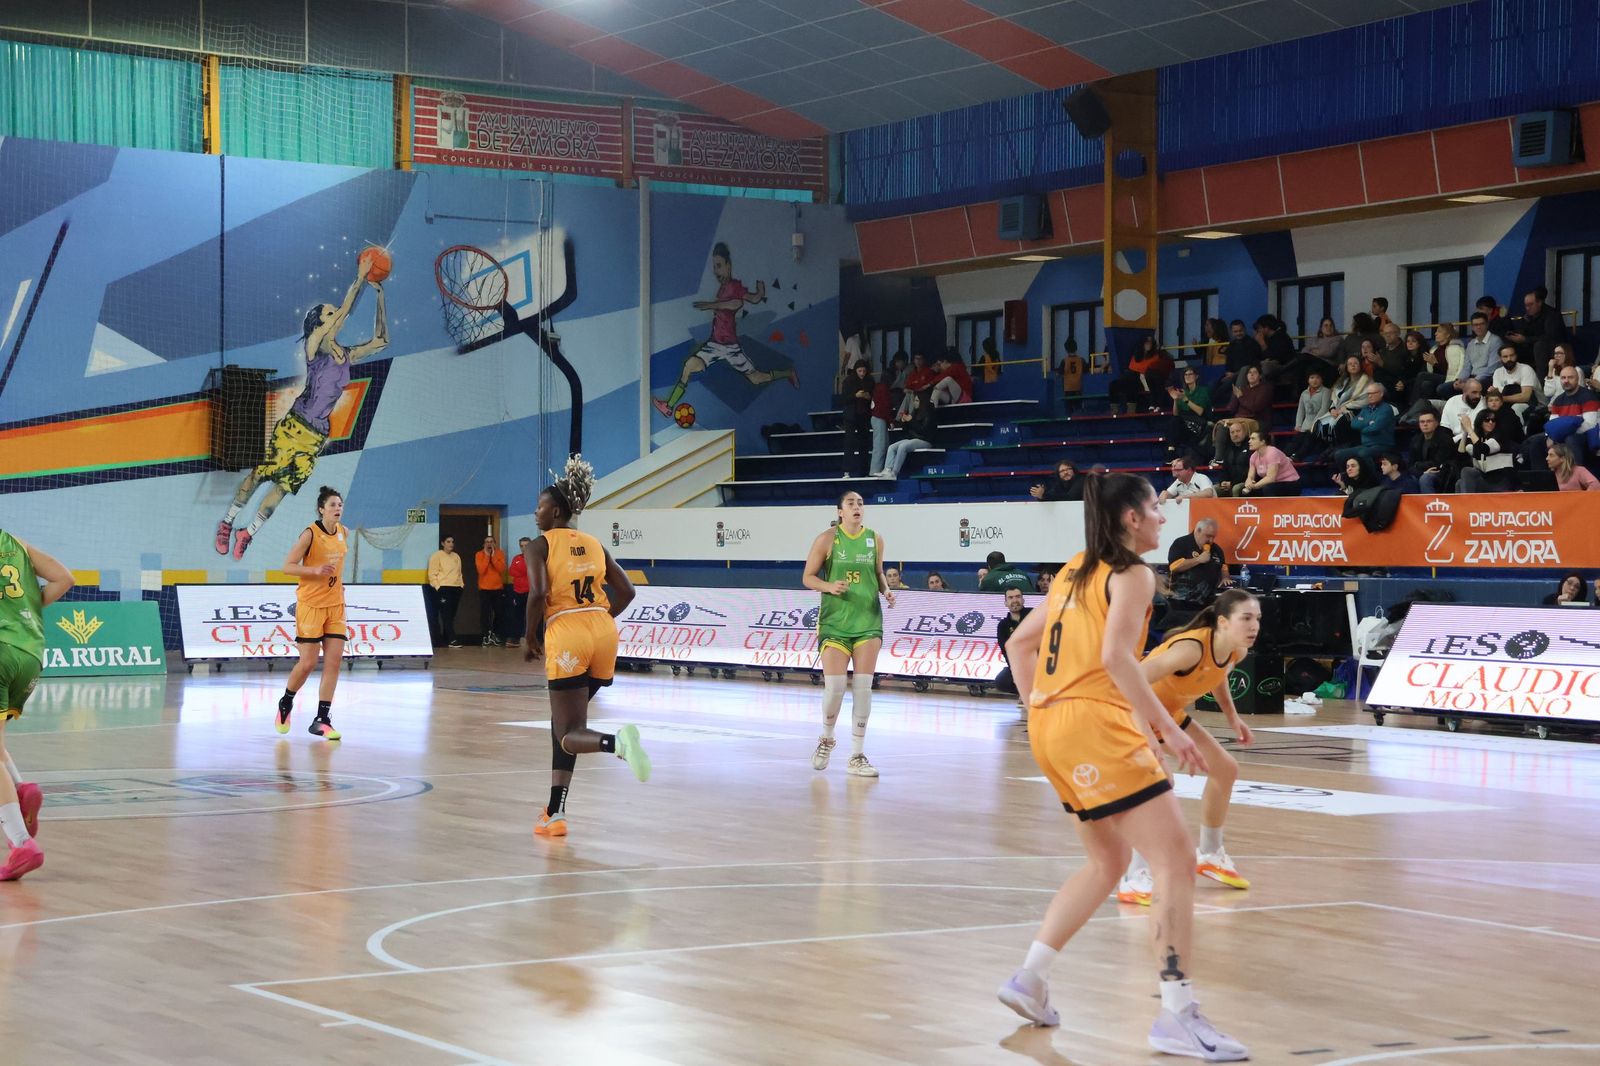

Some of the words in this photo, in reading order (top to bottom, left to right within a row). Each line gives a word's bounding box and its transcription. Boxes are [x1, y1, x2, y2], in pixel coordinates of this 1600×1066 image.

[478, 112, 600, 138] AYUNTAMIENTO
[477, 129, 502, 150] DE
[508, 132, 600, 159] ZAMORA
[542, 164, 595, 174] DEPORTES
[690, 148, 714, 166] DE
[720, 150, 801, 171] ZAMORA
[620, 529, 643, 540] ZAMORA
[725, 529, 751, 540] ZAMORA
[971, 527, 1003, 539] ZAMORA
[1268, 540, 1348, 562] ZAMORA
[1464, 540, 1560, 564] ZAMORA
[846, 570, 861, 584] 55
[571, 576, 595, 604] 14
[211, 602, 283, 620] IES
[628, 604, 668, 621] IES
[755, 608, 802, 626] IES
[901, 613, 955, 632] IES
[619, 624, 716, 646] CLAUDIO
[1420, 632, 1502, 656] IES
[70, 646, 161, 666] RURAL
[622, 644, 691, 659] MOYANO
[1046, 621, 1063, 676] 9
[751, 652, 823, 666] MOYAN
[899, 660, 991, 677] MOYANO
[1423, 690, 1572, 715] MOYANO
